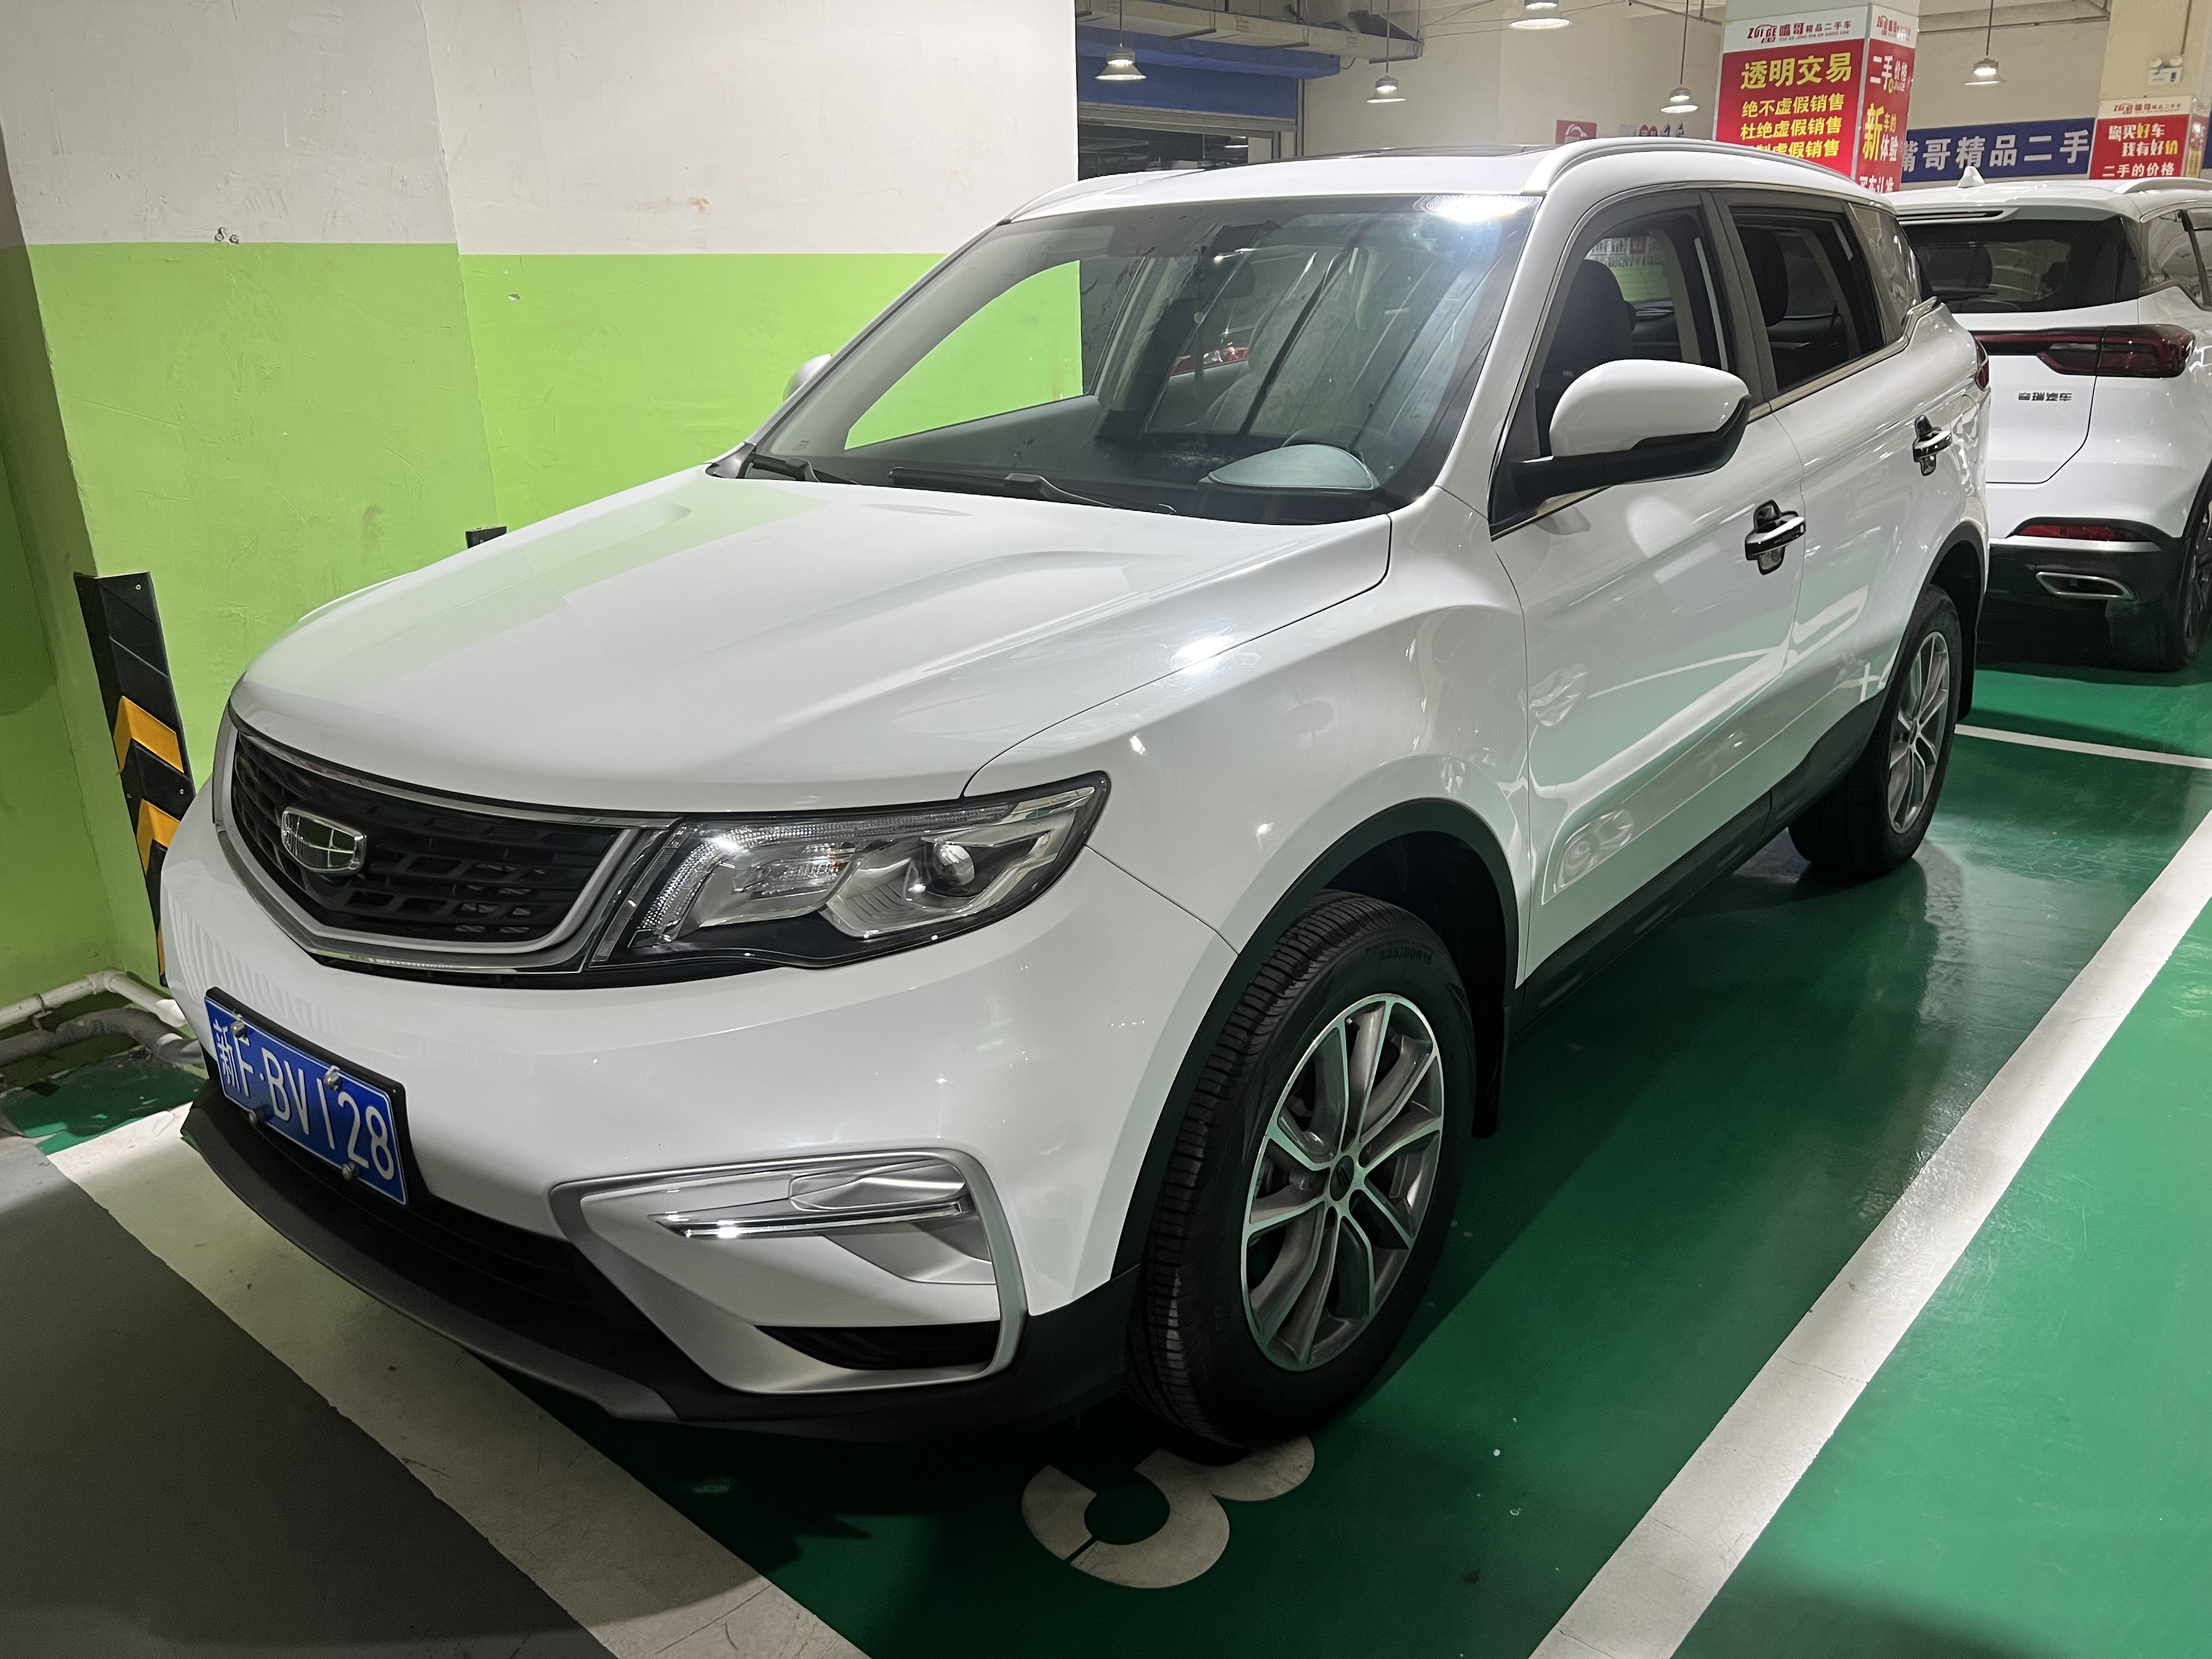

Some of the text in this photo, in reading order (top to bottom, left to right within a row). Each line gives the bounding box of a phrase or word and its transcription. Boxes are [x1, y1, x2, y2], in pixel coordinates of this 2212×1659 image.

[1740, 52, 1852, 90] 透明交易
[1870, 55, 1893, 90] 二手
[1741, 93, 1844, 117] 绝不虚假销售
[1740, 116, 1842, 140] 杜绝虚假销售
[1863, 103, 1884, 161] 新
[1884, 112, 1897, 133] 车的
[1750, 138, 1840, 159] 虚假销售
[1880, 134, 1898, 161] 体验
[2102, 162, 2175, 178] 二手的价格
